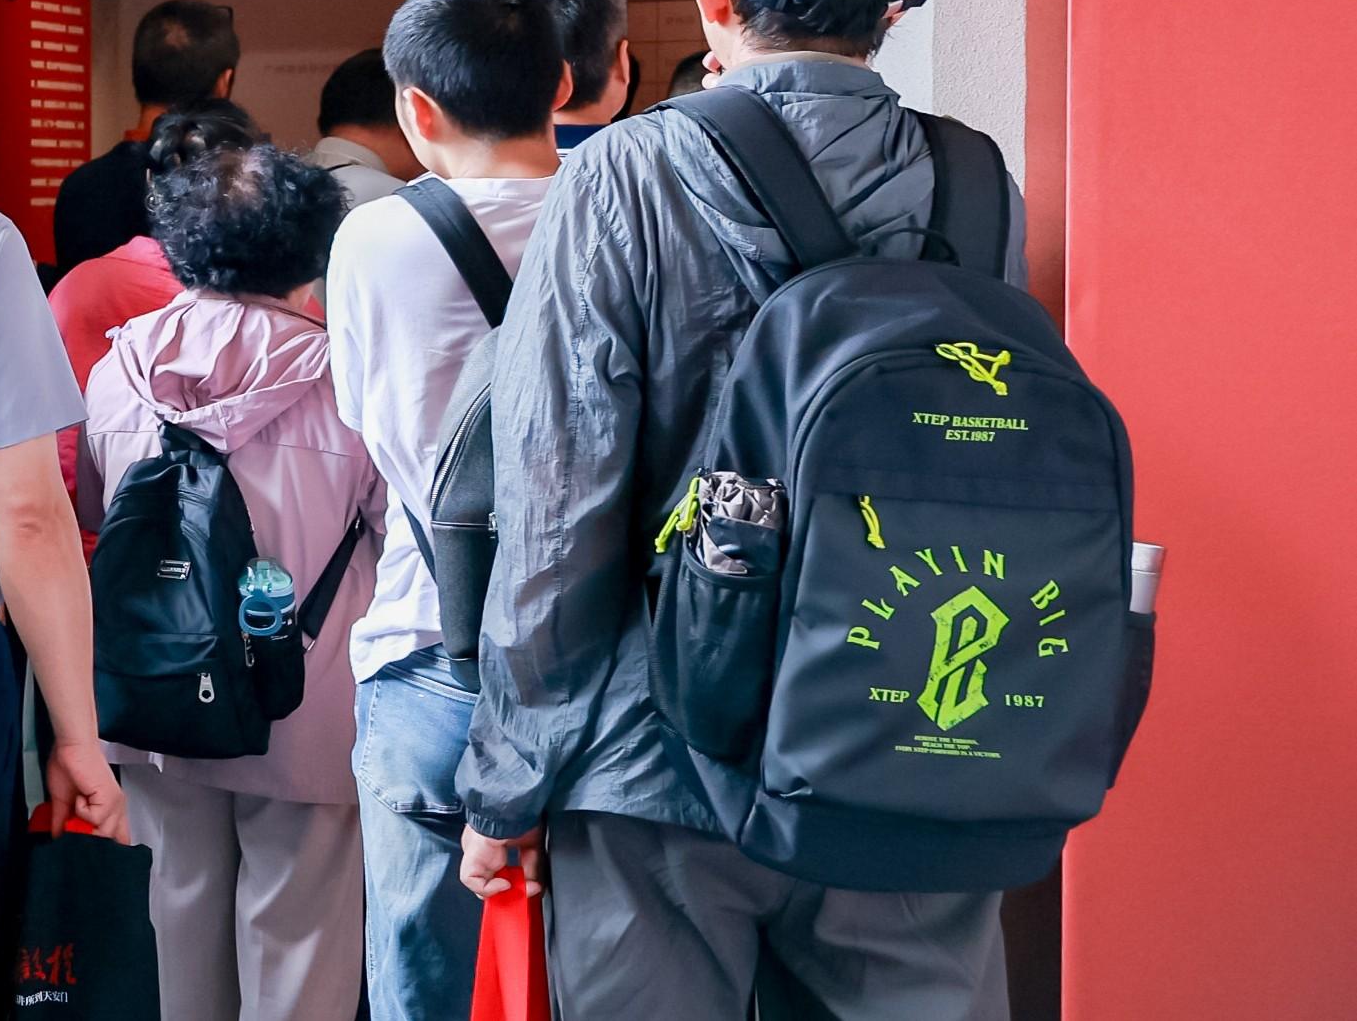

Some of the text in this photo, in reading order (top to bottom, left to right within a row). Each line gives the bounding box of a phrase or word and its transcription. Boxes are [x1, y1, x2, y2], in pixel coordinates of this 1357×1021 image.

[912, 412, 1029, 430] XTEP BASKETBALL
[846, 545, 1070, 658] PLAYIN BIG
[869, 688, 911, 703] XTEP
[1004, 694, 1045, 708] 1987
